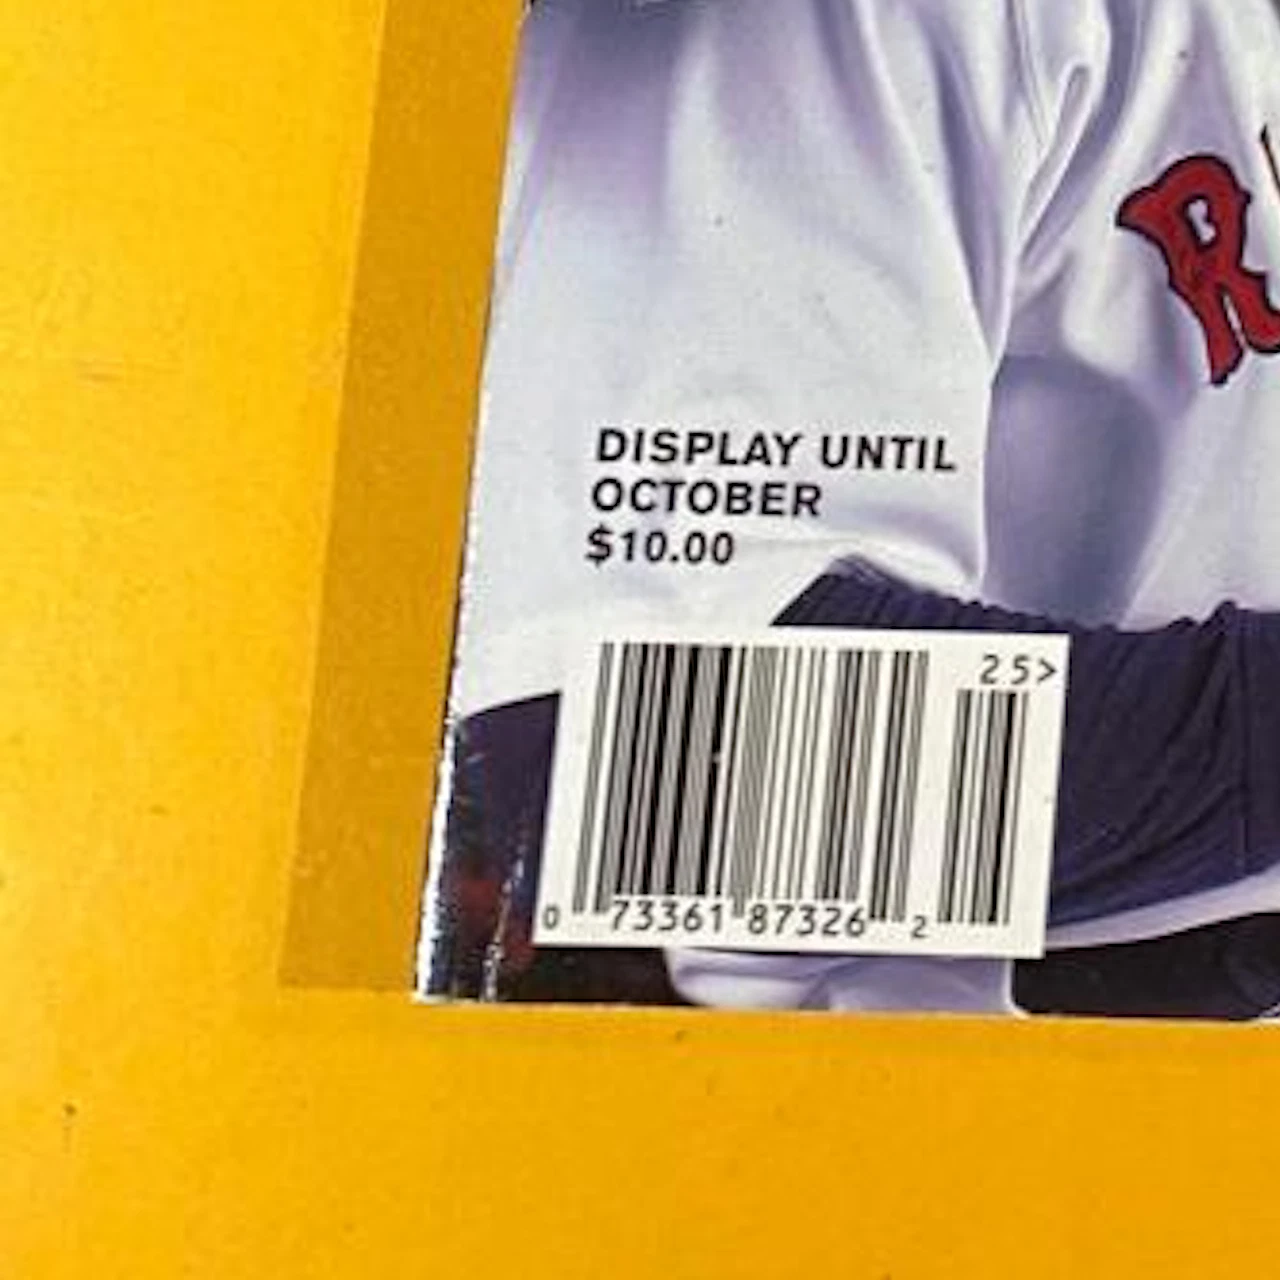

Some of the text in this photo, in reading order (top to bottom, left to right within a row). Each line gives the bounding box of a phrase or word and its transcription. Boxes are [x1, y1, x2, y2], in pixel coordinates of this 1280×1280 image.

[595, 427, 957, 473] DISPLAY UNTIL
[590, 476, 823, 518] OCTOBER
[585, 521, 735, 568] $10.00
[541, 898, 928, 940] 0 73361 87326 2
